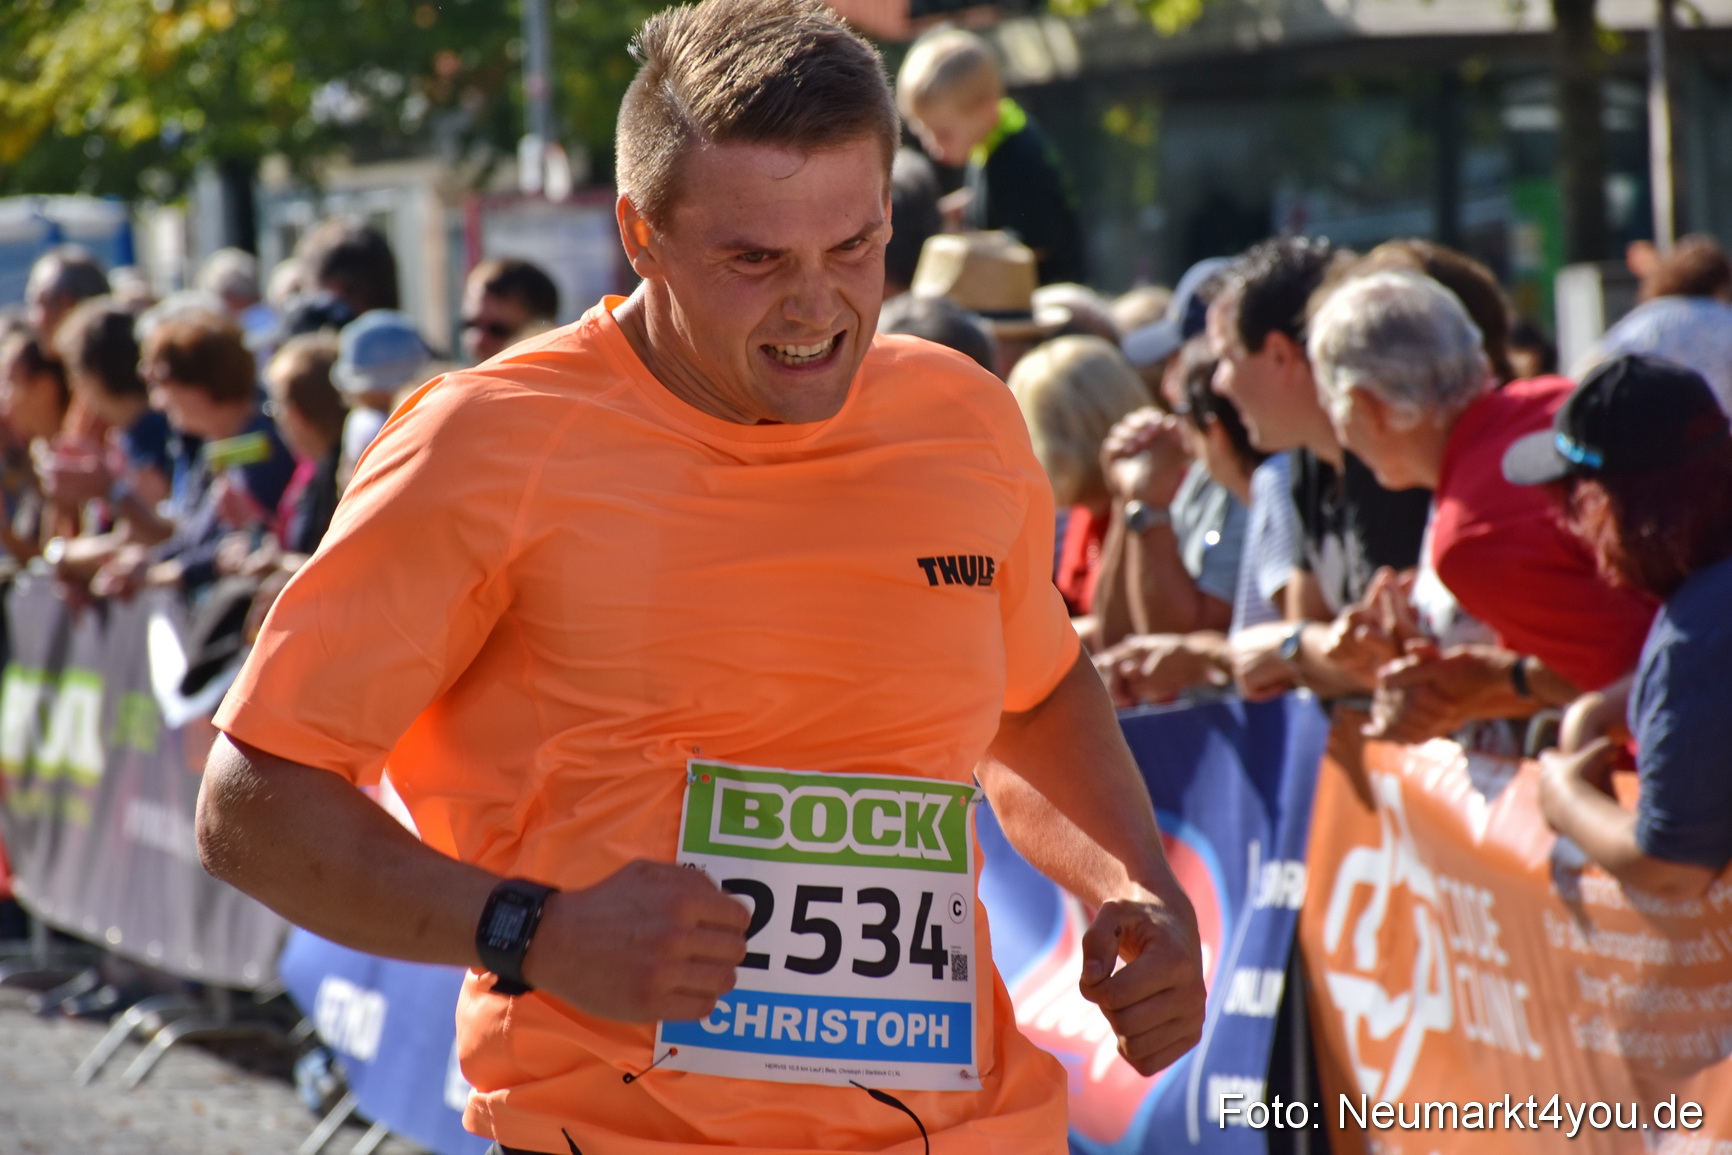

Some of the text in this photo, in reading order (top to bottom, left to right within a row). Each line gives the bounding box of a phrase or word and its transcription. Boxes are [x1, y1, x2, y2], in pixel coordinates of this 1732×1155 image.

[917, 555, 995, 586] THULE
[711, 779, 951, 859] BOCK
[721, 878, 949, 980] 2534
[953, 900, 962, 916] C
[699, 1000, 950, 1049] CHRISTOPH
